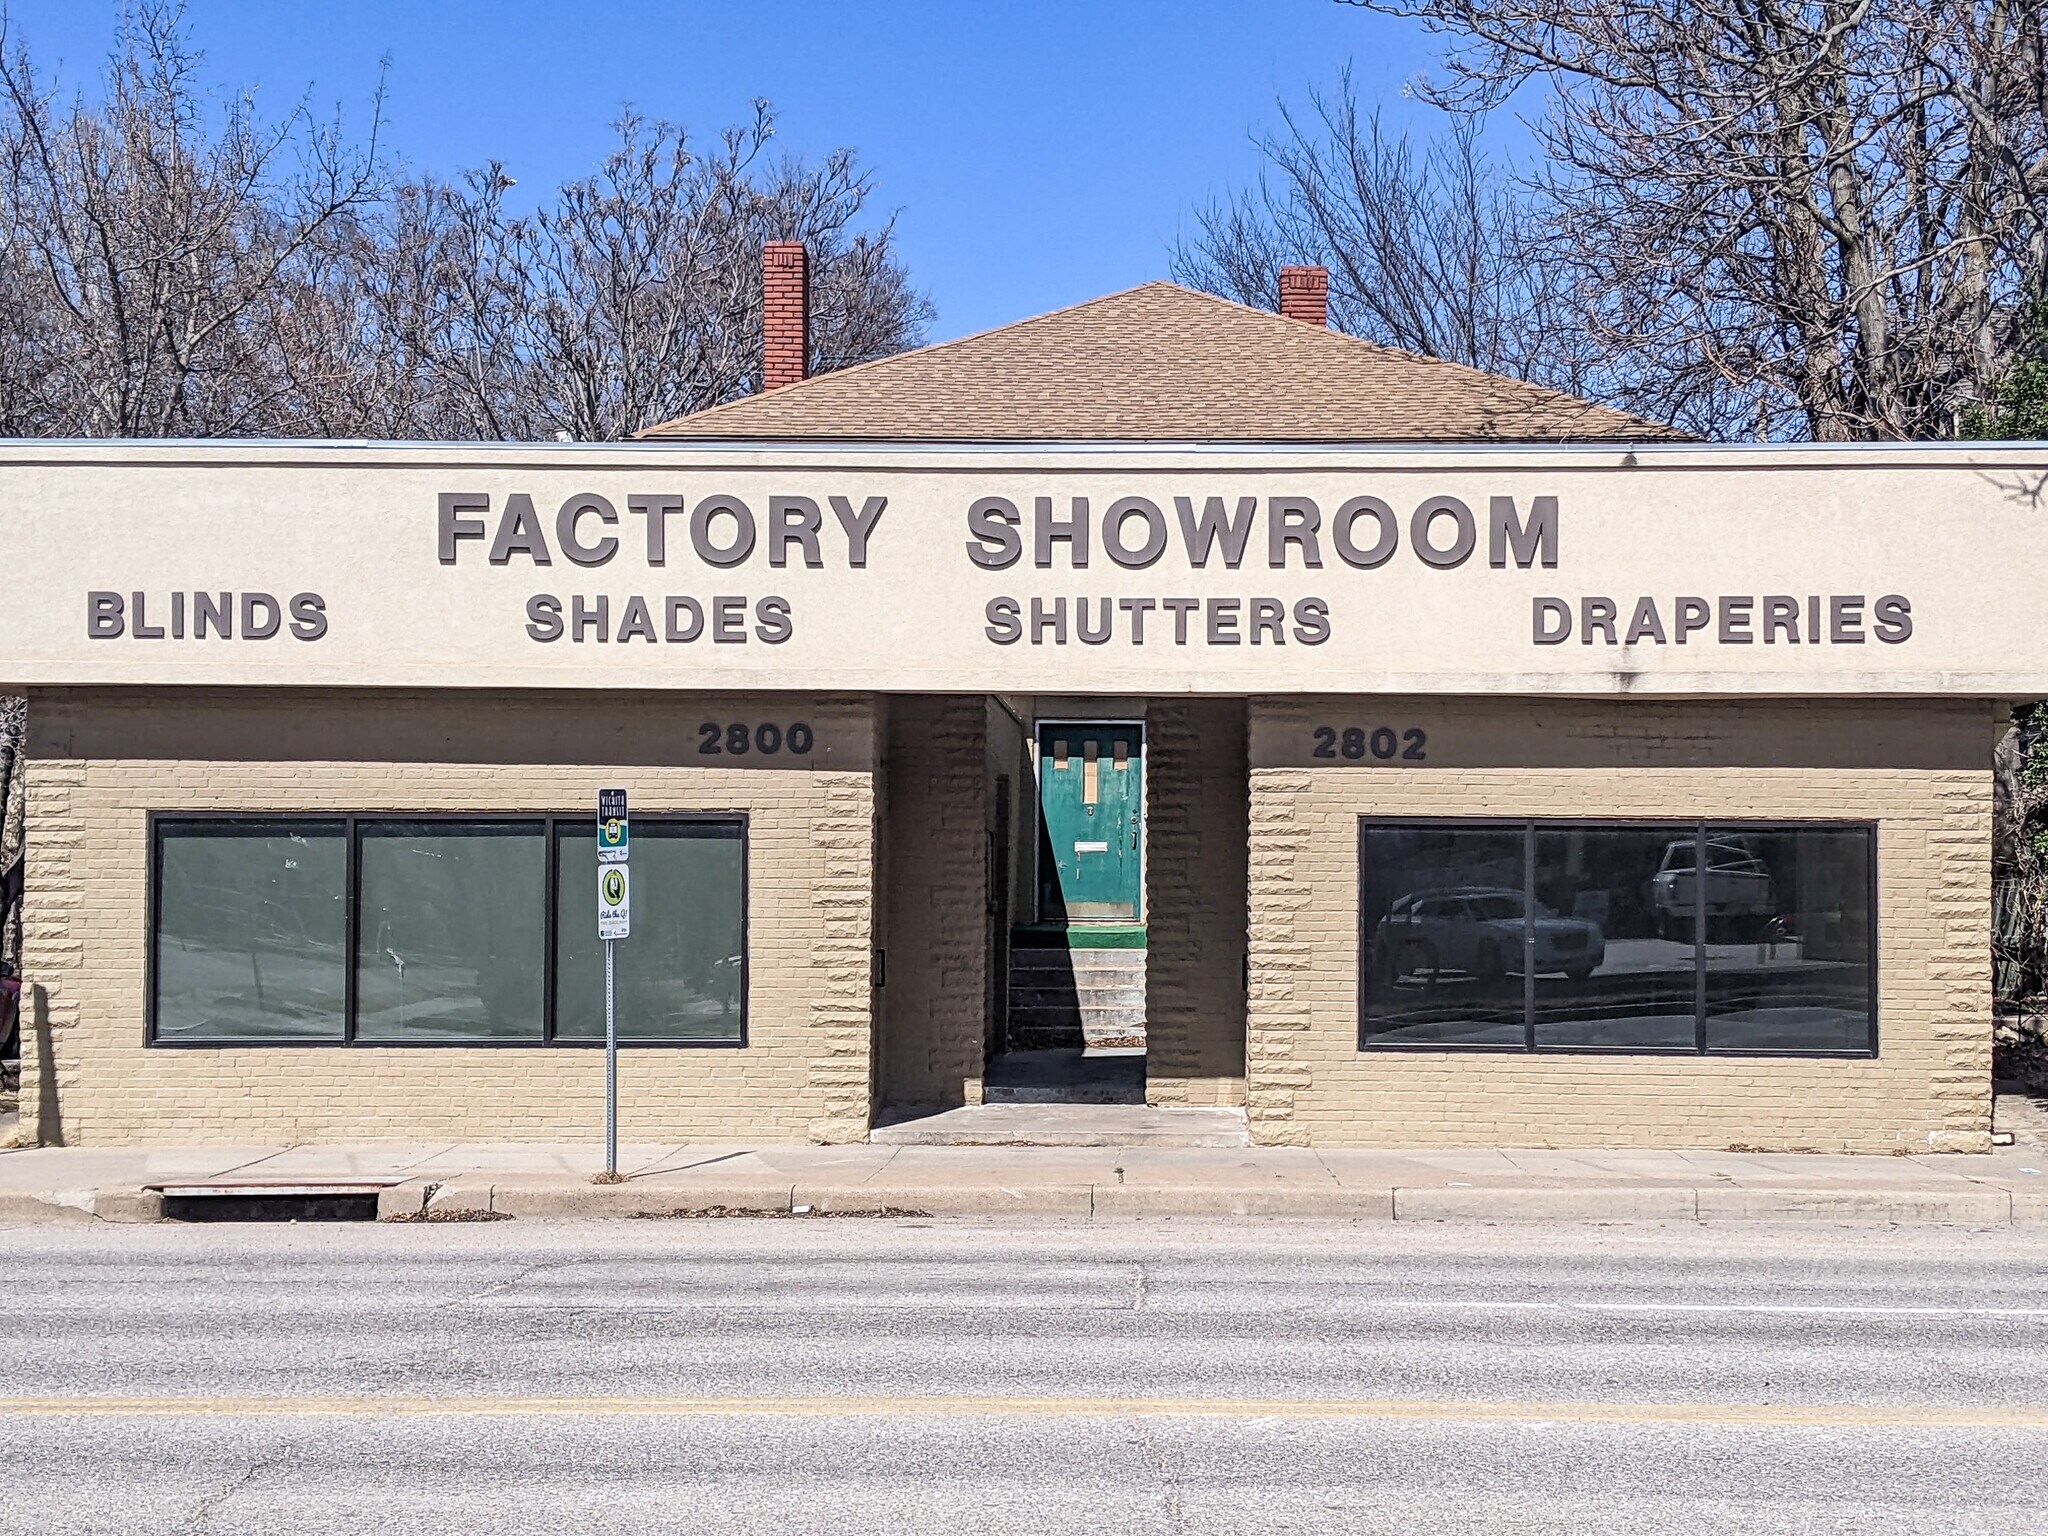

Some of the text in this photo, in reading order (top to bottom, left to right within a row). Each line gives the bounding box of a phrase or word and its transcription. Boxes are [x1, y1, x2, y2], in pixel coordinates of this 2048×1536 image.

[438, 493, 1558, 571] FACTORY SHOWROOM
[88, 592, 328, 641] BLINDS
[526, 594, 792, 644] SHADES
[985, 597, 1330, 646] SHUTTERS
[1533, 595, 1912, 645] DRAPERIES
[698, 722, 814, 755] 2800
[1313, 726, 1427, 760] 2802
[601, 795, 625, 806] WICHITA
[601, 806, 625, 817] TRANSIT
[612, 909, 620, 918] the
